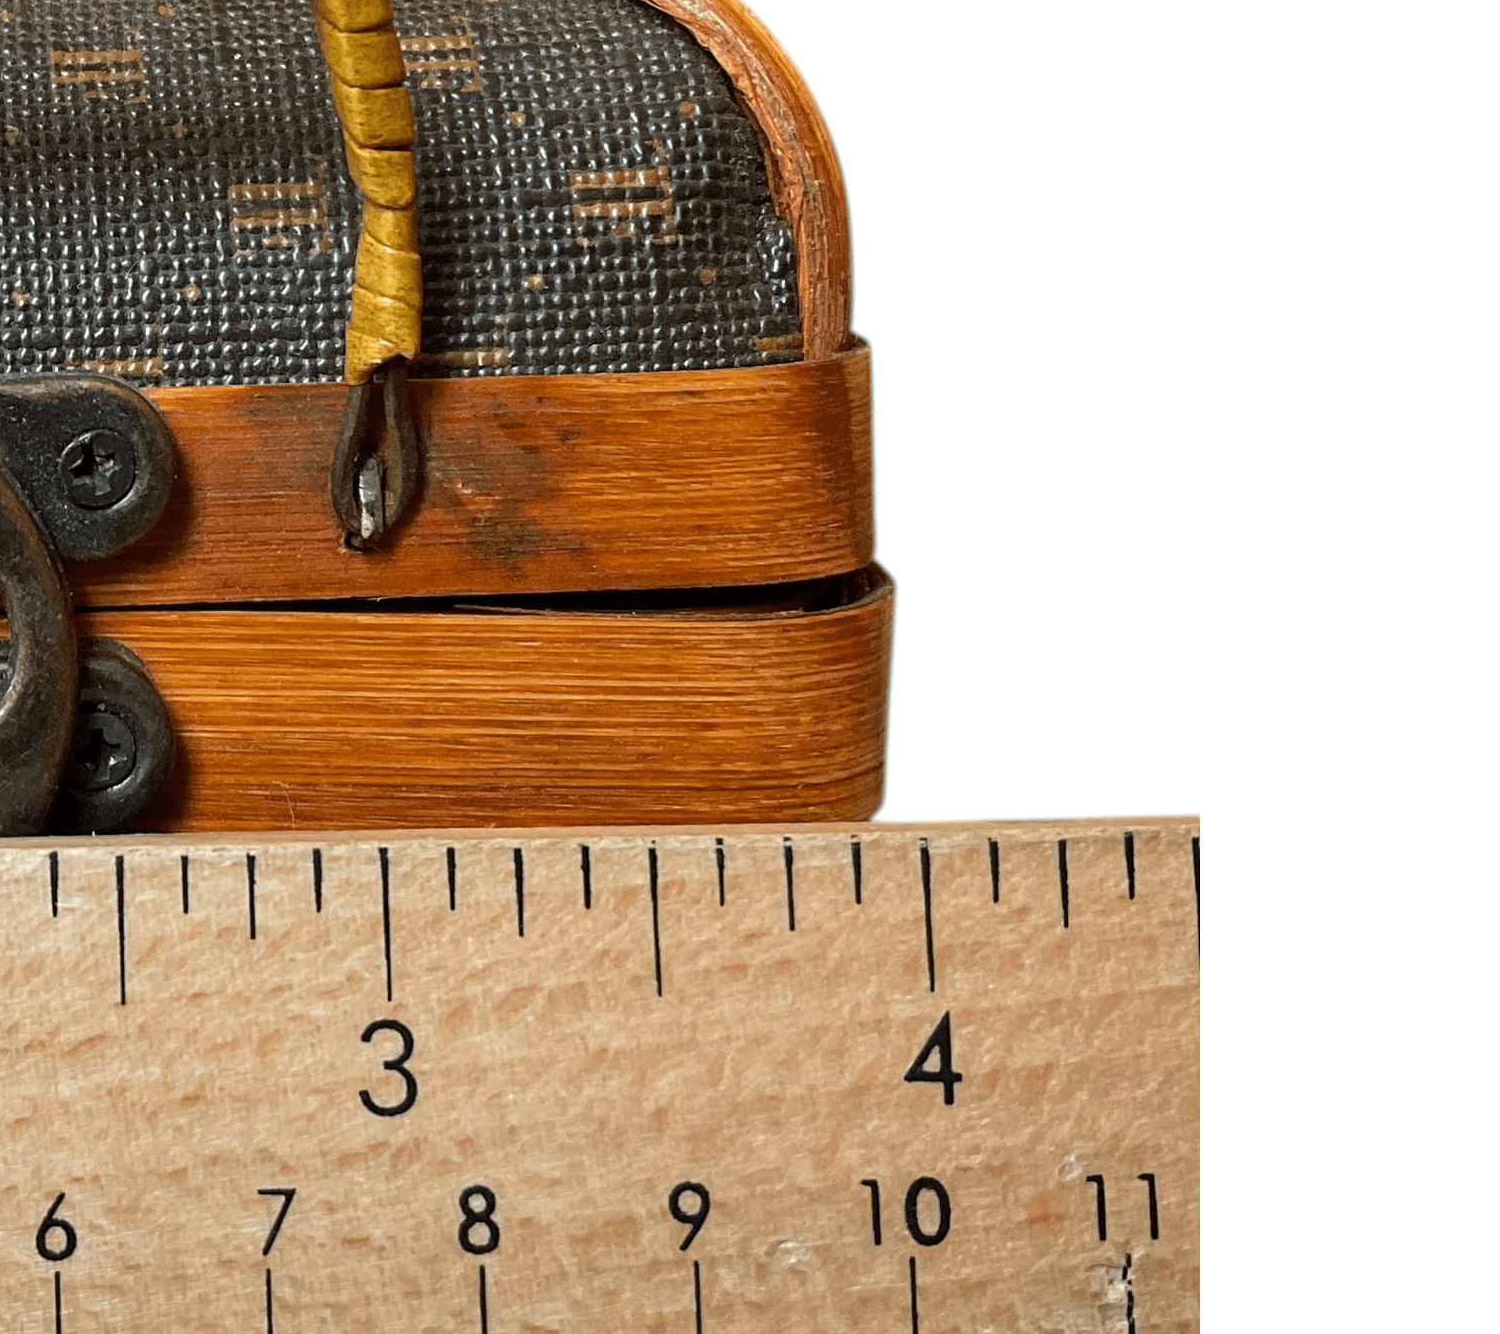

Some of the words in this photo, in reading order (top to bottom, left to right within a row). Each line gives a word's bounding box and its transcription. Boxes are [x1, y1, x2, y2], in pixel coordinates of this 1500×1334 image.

[358, 1019, 418, 1118] 3
[903, 1010, 963, 1106] 4
[35, 1192, 78, 1263] 6
[257, 1187, 297, 1257] 7
[457, 1184, 501, 1256] 8
[668, 1180, 711, 1252] 9
[860, 1176, 952, 1247] 10
[1085, 1172, 1160, 1242] 11
